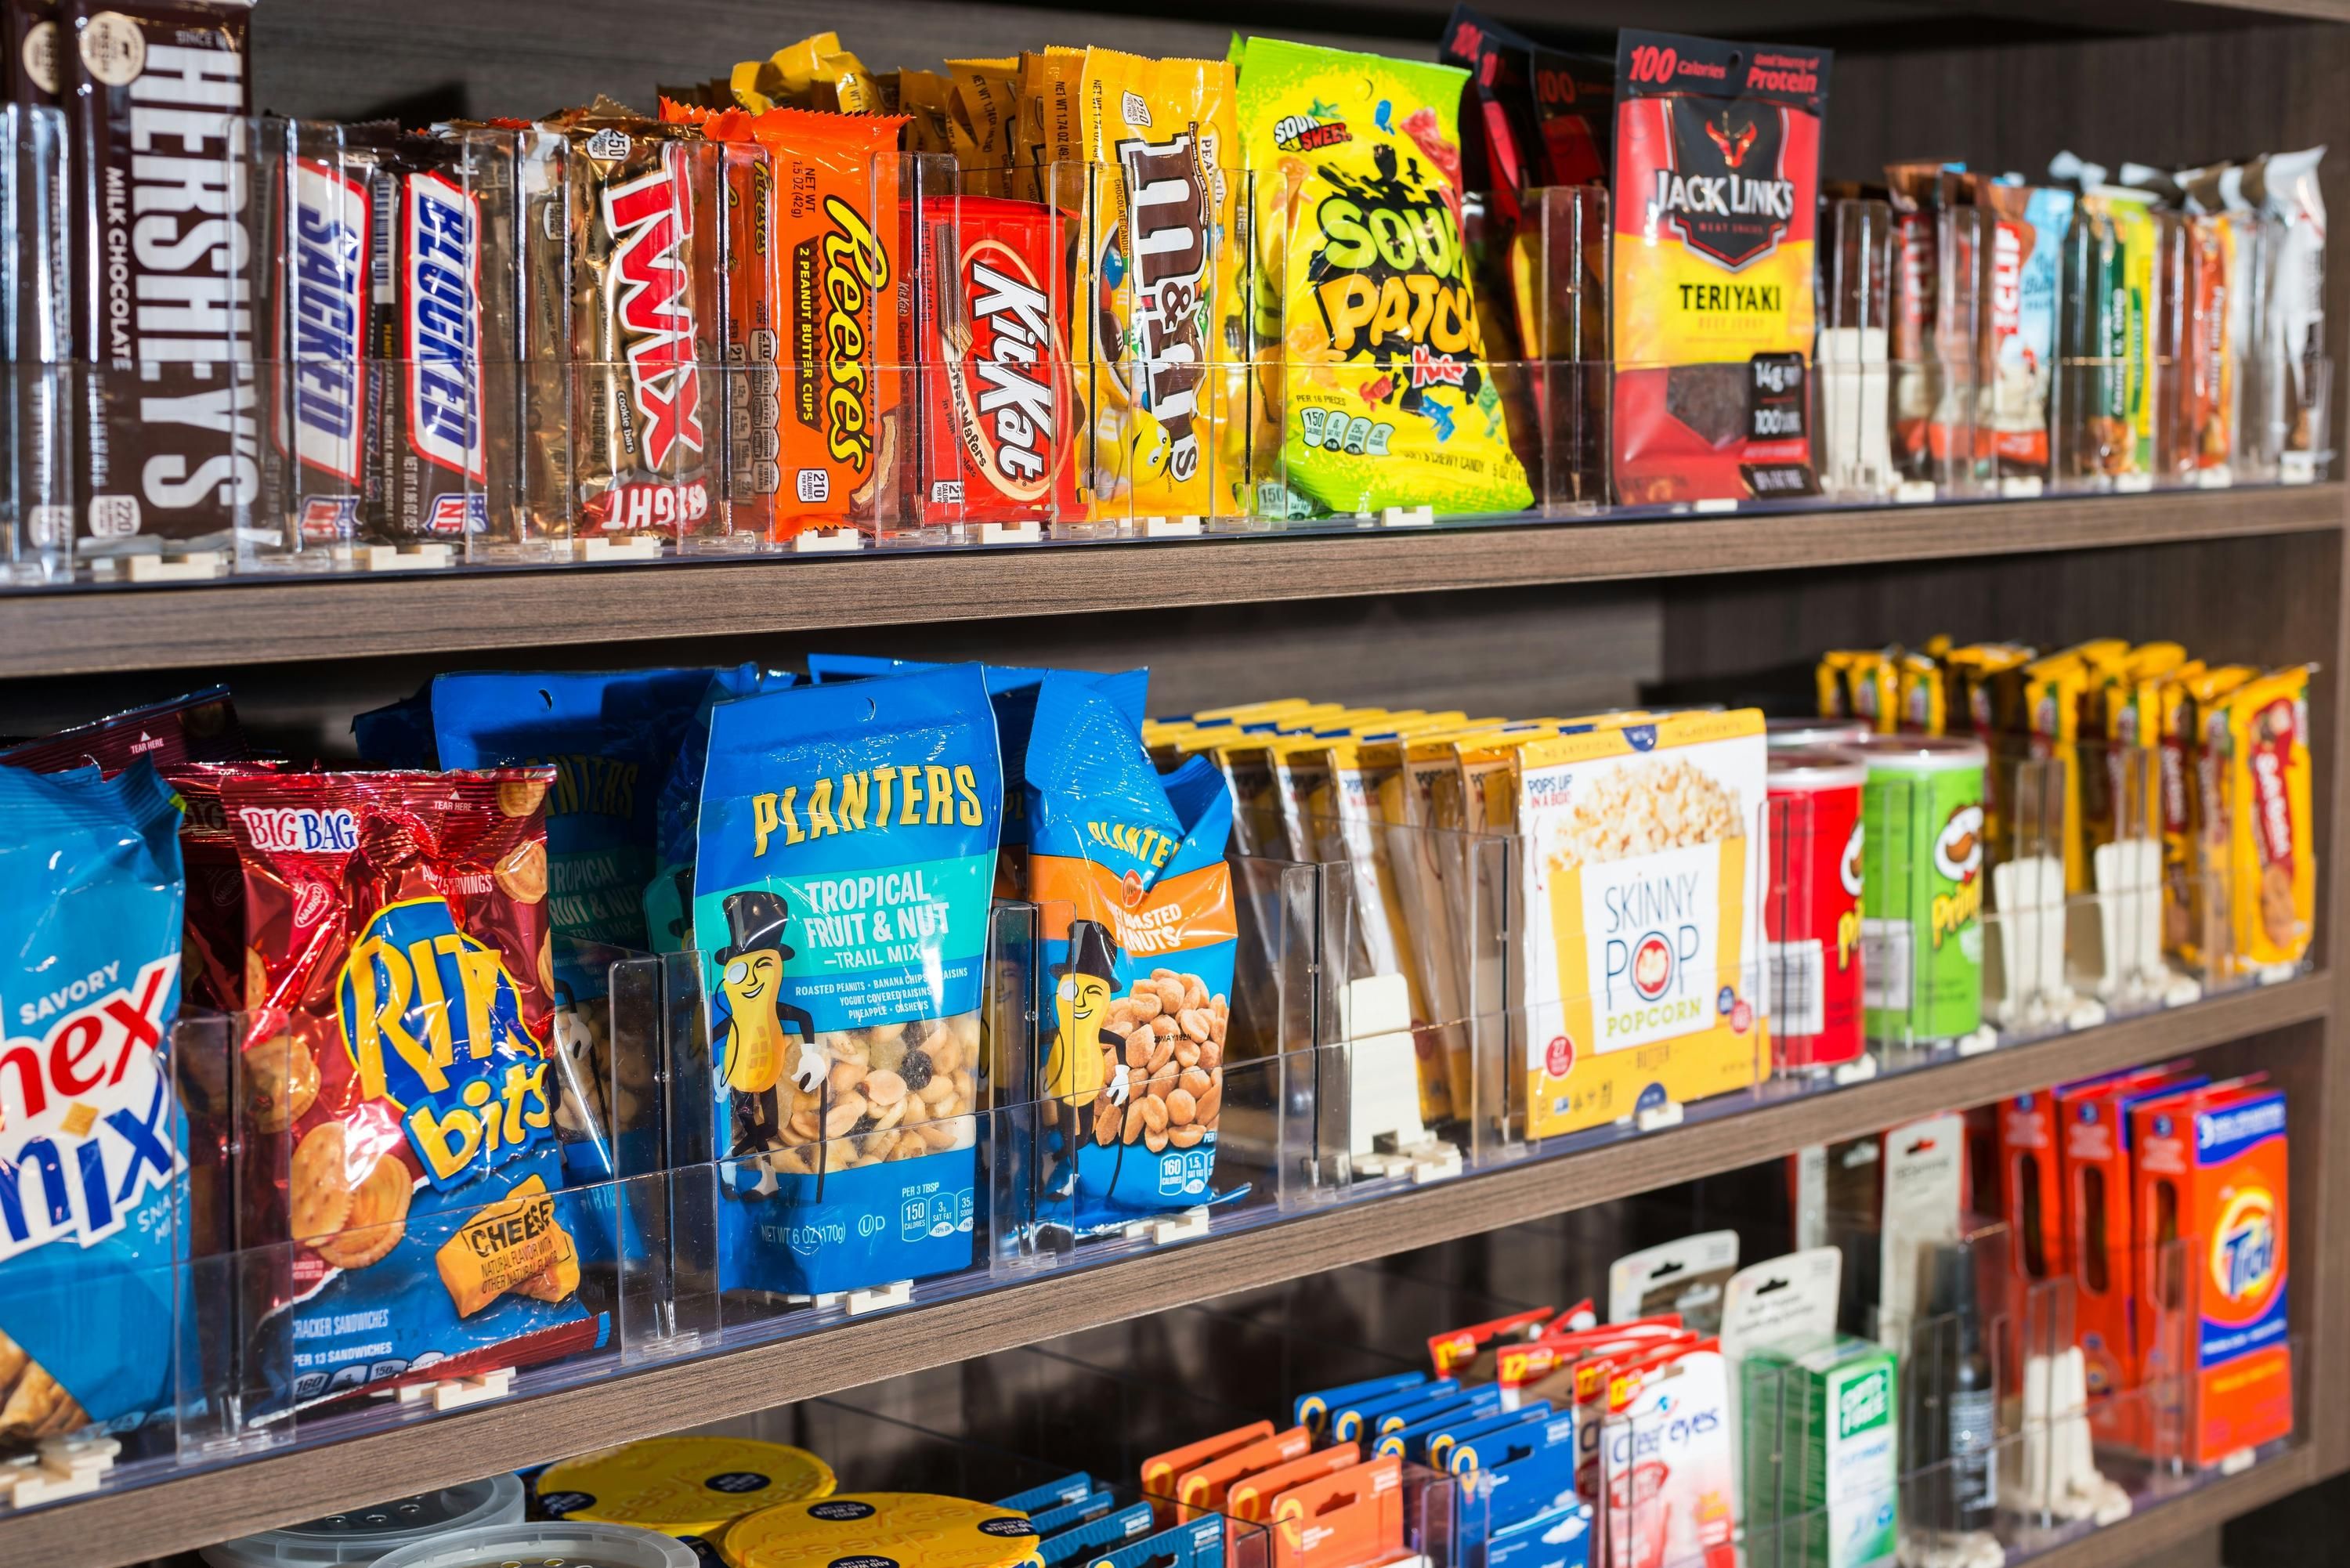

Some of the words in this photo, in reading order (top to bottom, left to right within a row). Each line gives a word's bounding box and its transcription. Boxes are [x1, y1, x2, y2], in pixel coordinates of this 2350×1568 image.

[1629, 45, 1676, 83] 100
[1677, 60, 1726, 78] Calories
[1746, 66, 1817, 92] Protein
[1055, 81, 1065, 95] NET
[1056, 99, 1066, 110] WT
[1134, 99, 1149, 124] 250
[1056, 114, 1067, 130] 1.74
[1058, 132, 1068, 143] OZ
[609, 130, 626, 157] 250
[792, 161, 803, 174] 1.5
[792, 175, 804, 190] OZ
[805, 168, 816, 191] NET
[105, 166, 127, 224] MILK
[806, 193, 816, 213] WT
[1114, 179, 1126, 224] CHOCOLATE
[1653, 169, 1730, 217] JACK
[1729, 173, 1794, 220] LINK'S
[799, 247, 809, 256] 2
[1119, 224, 1130, 258] CANDIES
[129, 44, 259, 508] HERSHEY'S
[800, 259, 812, 319] PEANUT
[108, 227, 133, 371] CHOCOLATE
[898, 281, 910, 317] KitKat
[1679, 285, 1781, 312] TERIYAKI
[418, 192, 478, 450] BLOCKED
[822, 194, 890, 474] Reese's
[801, 324, 812, 378] BUTTER
[971, 258, 1058, 482] KitKat
[802, 382, 813, 421] CUPS
[1296, 394, 1311, 403] PER
[1324, 395, 1347, 406] PIECES
[617, 392, 631, 428] cookie
[624, 428, 635, 453] bars
[1305, 411, 1325, 428] 150
[960, 409, 988, 468] Wafers
[813, 473, 826, 498] 210
[117, 501, 134, 535] 220
[601, 483, 707, 530] RIGHT
[130, 743, 146, 754] TEAR
[147, 739, 164, 750] HERE
[1527, 777, 1556, 795] POPS
[1558, 775, 1573, 790] UP
[434, 801, 454, 811] TEAR
[454, 802, 472, 811] HERE
[752, 764, 984, 858] PLANTERS
[244, 810, 298, 847] BIG
[299, 811, 357, 851] BAG
[1087, 822, 1182, 869] PLANTE
[298, 886, 322, 926] NABISCO
[591, 892, 610, 919] &
[804, 869, 932, 915] TROPICAL
[1604, 870, 1700, 934] SKINNY
[804, 912, 867, 949] FRUIT
[873, 910, 894, 941] &
[898, 902, 950, 942] NUT
[833, 947, 884, 970] TRAIL
[887, 943, 922, 964] MIX
[1606, 923, 1700, 1011] POP
[19, 960, 120, 1026] SAVORY
[795, 982, 835, 996] ROASTED
[836, 981, 866, 993] PEANUTS
[873, 974, 904, 989] BANANA
[904, 973, 928, 985] CHIPS
[839, 993, 866, 1007] YOGURT
[866, 990, 901, 1004] COVERED
[901, 987, 932, 1000] RAISINS
[848, 1005, 888, 1020] PINEAPPLE
[895, 999, 930, 1013] CASHEWS
[1606, 998, 1703, 1038] POPCORN
[408, 1063, 551, 1180] bits
[1163, 1158, 1182, 1176] 160
[902, 1186, 915, 1198] PER
[916, 1185, 921, 1195] 3
[921, 1181, 940, 1194] TBSP
[904, 1219, 926, 1230] CALORIES
[906, 1202, 925, 1221] 150
[932, 1213, 942, 1222] SAT
[943, 1212, 953, 1221] FAT
[470, 1199, 552, 1258] CHEESE
[761, 1224, 776, 1244] NET
[776, 1225, 791, 1245] WT
[792, 1229, 800, 1245] 6
[801, 1227, 817, 1244] OZ
[481, 1254, 512, 1278] NATURAL
[512, 1243, 537, 1267] FLAVOR
[482, 1274, 506, 1294] OTHER
[506, 1259, 539, 1287] NATURAL
[293, 1316, 333, 1339] CRACKER
[333, 1309, 389, 1336] SANDWICHES
[293, 1353, 313, 1367] PER
[314, 1351, 327, 1364] 13
[327, 1342, 392, 1364] SANDWICHES
